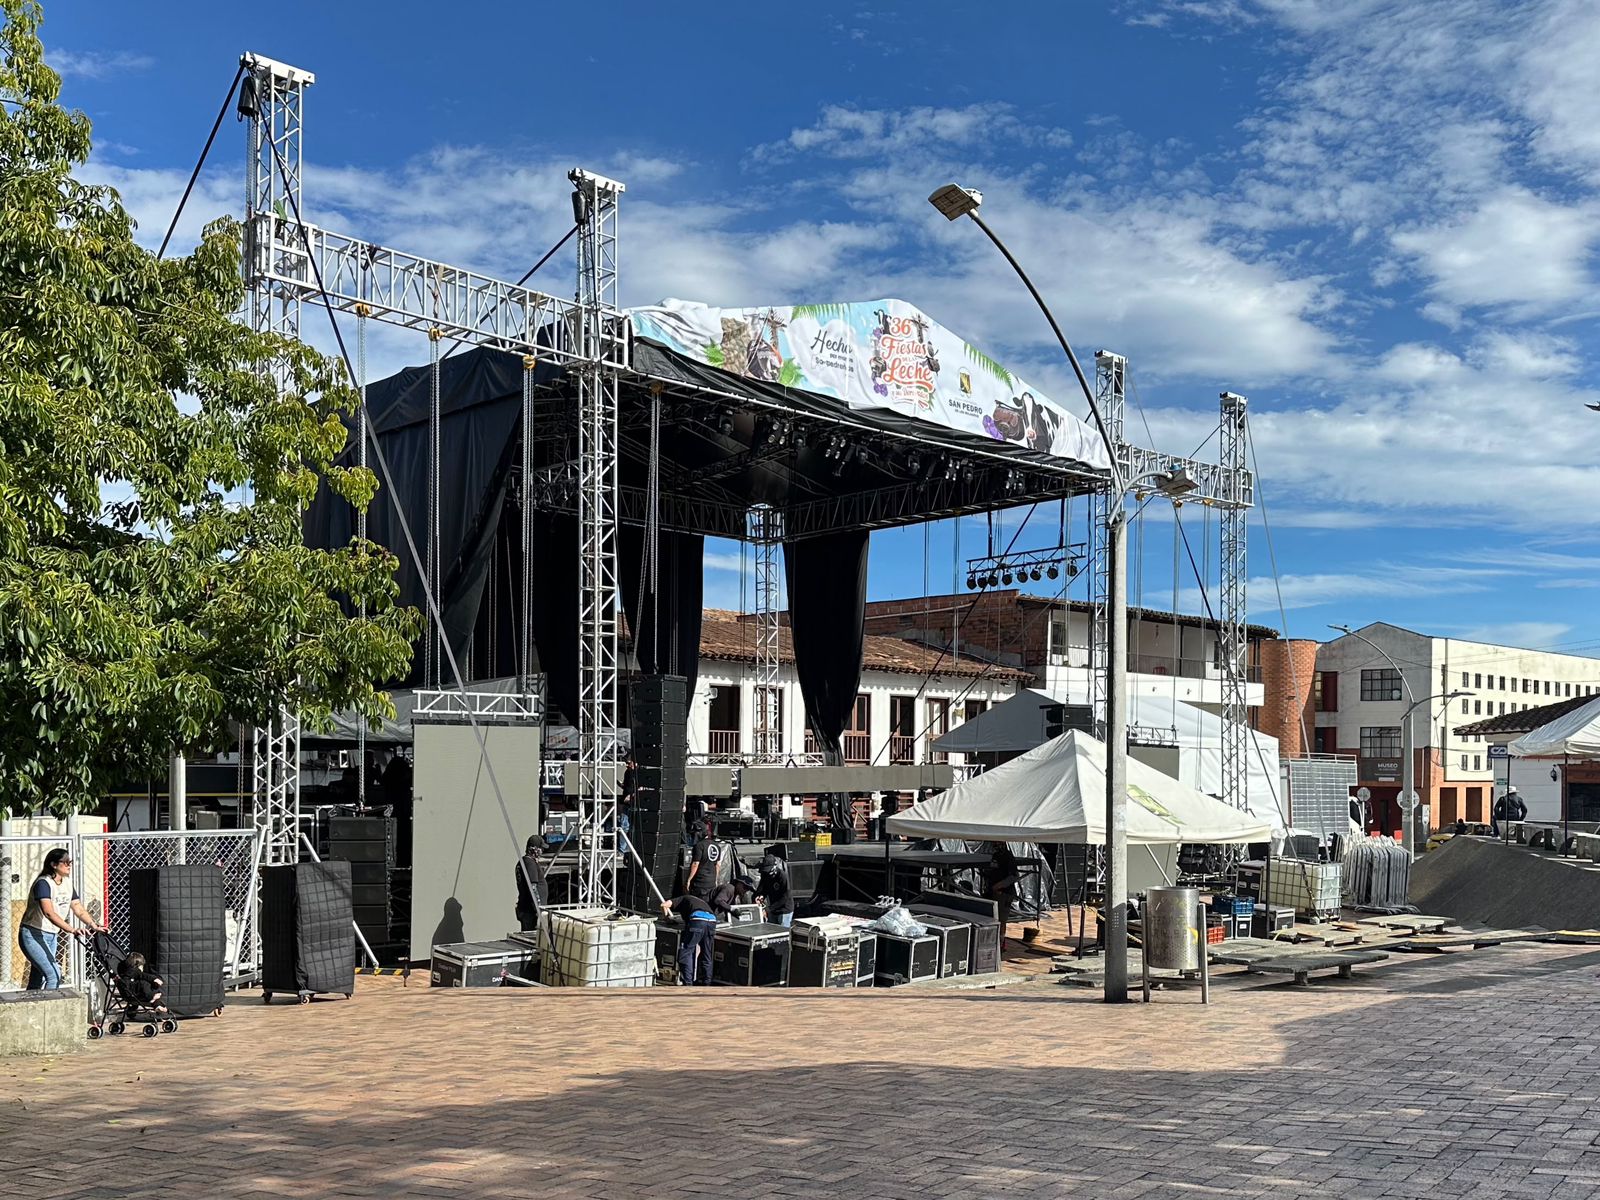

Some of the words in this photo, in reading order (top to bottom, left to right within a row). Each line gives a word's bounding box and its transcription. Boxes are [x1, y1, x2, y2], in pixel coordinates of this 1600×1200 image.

[891, 317, 911, 335] 36
[881, 336, 926, 360] Fiestas
[883, 357, 933, 386] Leche
[949, 399, 961, 409] SAN
[962, 403, 983, 415] PEDRO
